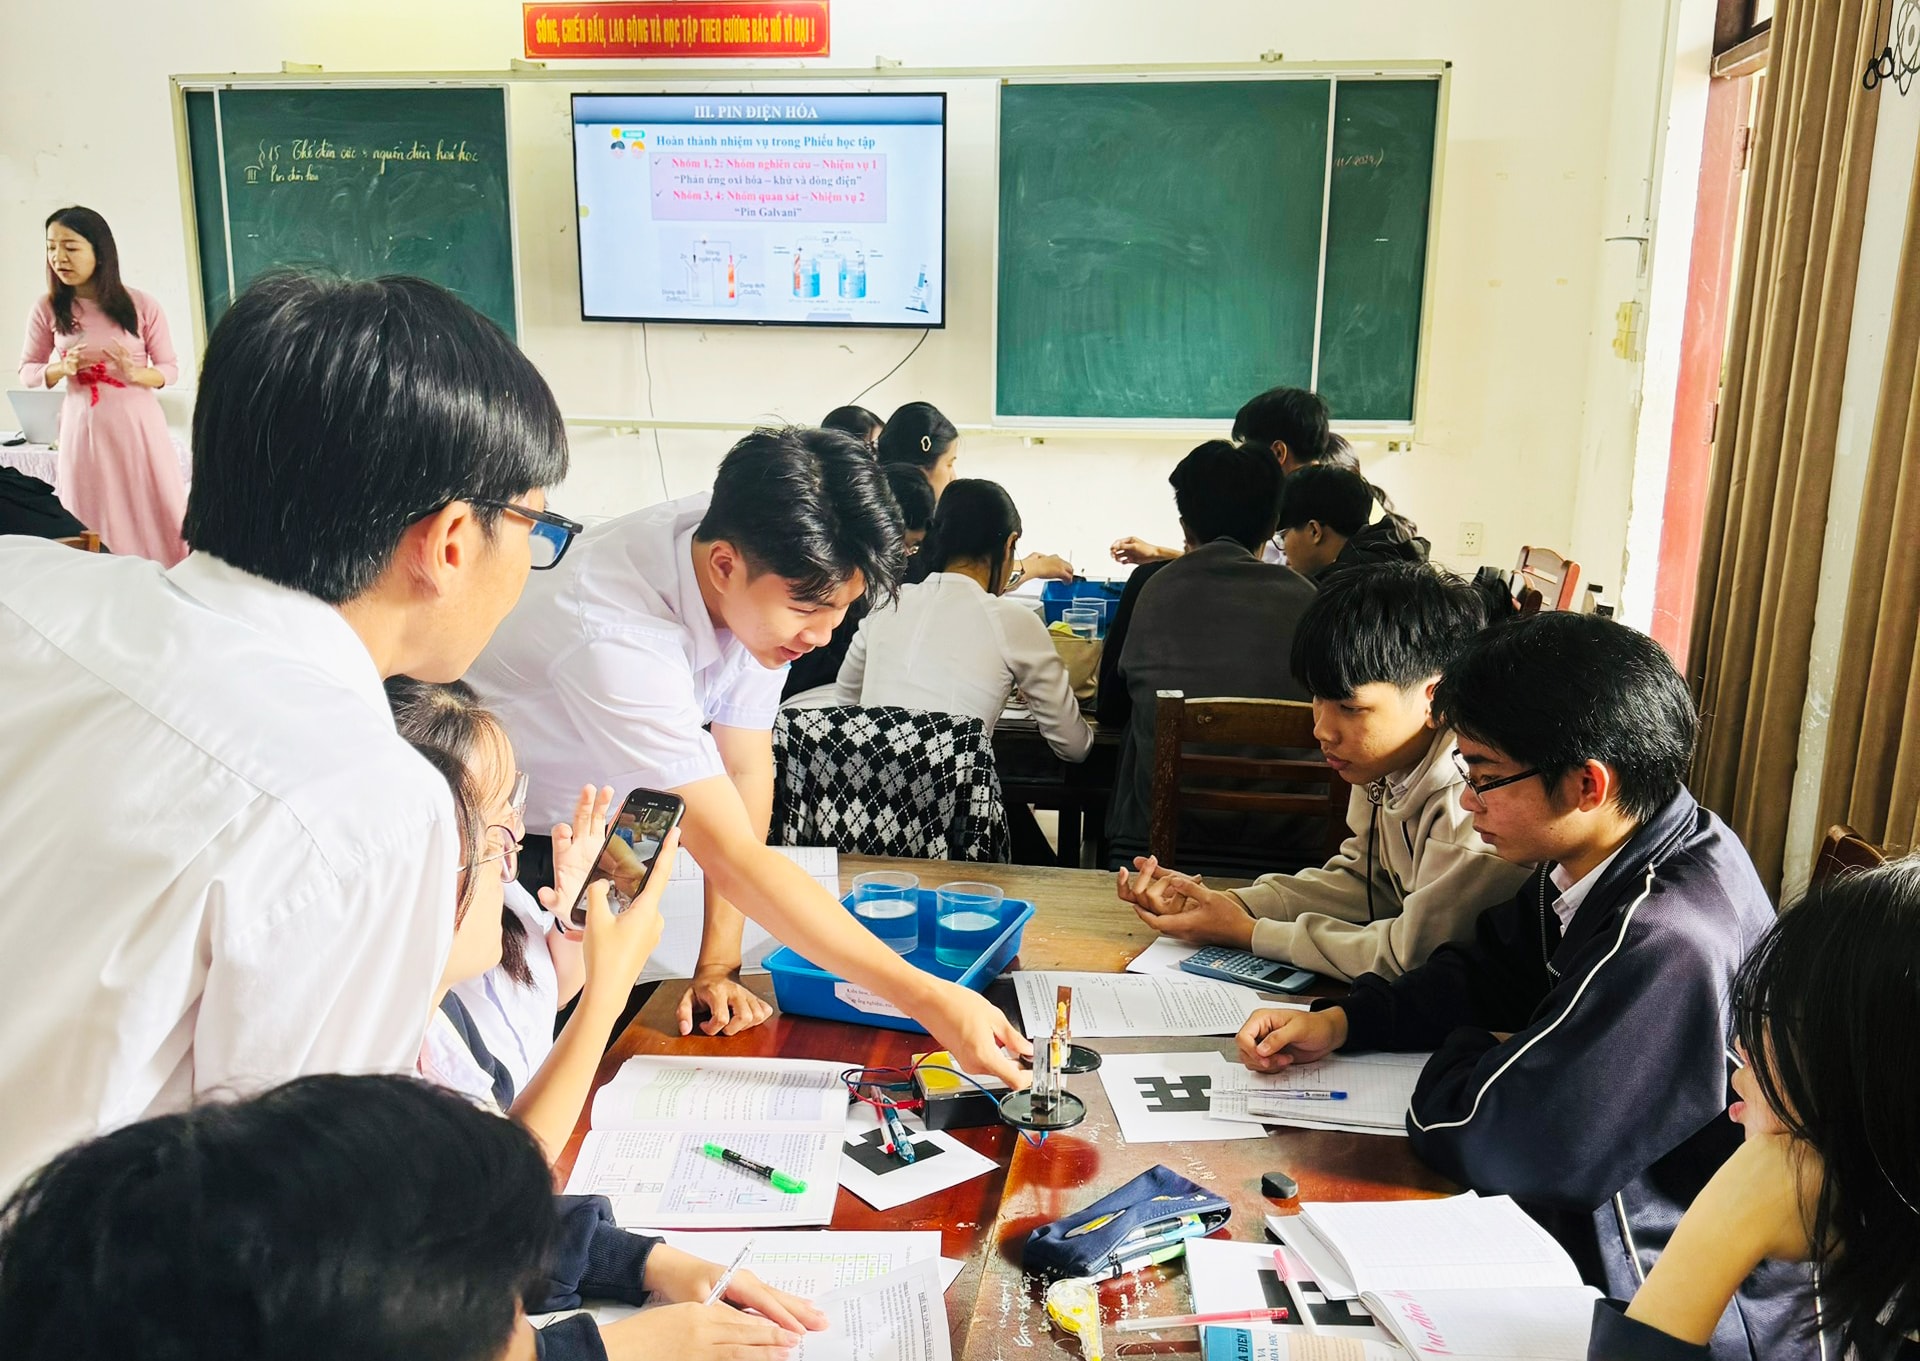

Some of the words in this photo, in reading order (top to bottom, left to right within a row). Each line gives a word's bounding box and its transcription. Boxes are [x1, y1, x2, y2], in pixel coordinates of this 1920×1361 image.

[609, 17, 625, 43] LAO
[650, 13, 662, 43] VÀ
[663, 17, 680, 48] HỌC
[682, 14, 698, 48] TẬP
[700, 17, 721, 43] THEO
[752, 13, 768, 43] BÁC
[794, 17, 809, 48] ĐẠI
[694, 105, 715, 119] III.
[718, 105, 743, 119] PIN
[746, 103, 781, 121] ĐIỆN
[785, 101, 818, 119] HÓA
[656, 135, 684, 146] Hoàn
[687, 136, 717, 146] thành
[721, 136, 753, 148] nhiệm
[756, 138, 769, 149] vụ
[772, 138, 800, 149] trong
[804, 133, 833, 146] Phiếu
[837, 136, 855, 149] học
[858, 136, 875, 149] tập
[672, 159, 700, 168] Nhóm
[727, 159, 755, 168] Nhóm
[823, 159, 854, 171] Nhiệm
[857, 161, 869, 171] vụ
[872, 160, 876, 169] 1
[795, 176, 806, 185] và
[809, 176, 833, 186] dòng
[673, 191, 701, 200] Nhóm
[728, 191, 756, 200] Nhóm
[759, 193, 783, 203] quan
[811, 192, 842, 203] Nhiệm
[845, 194, 857, 204] vụ
[859, 192, 865, 202] 2
